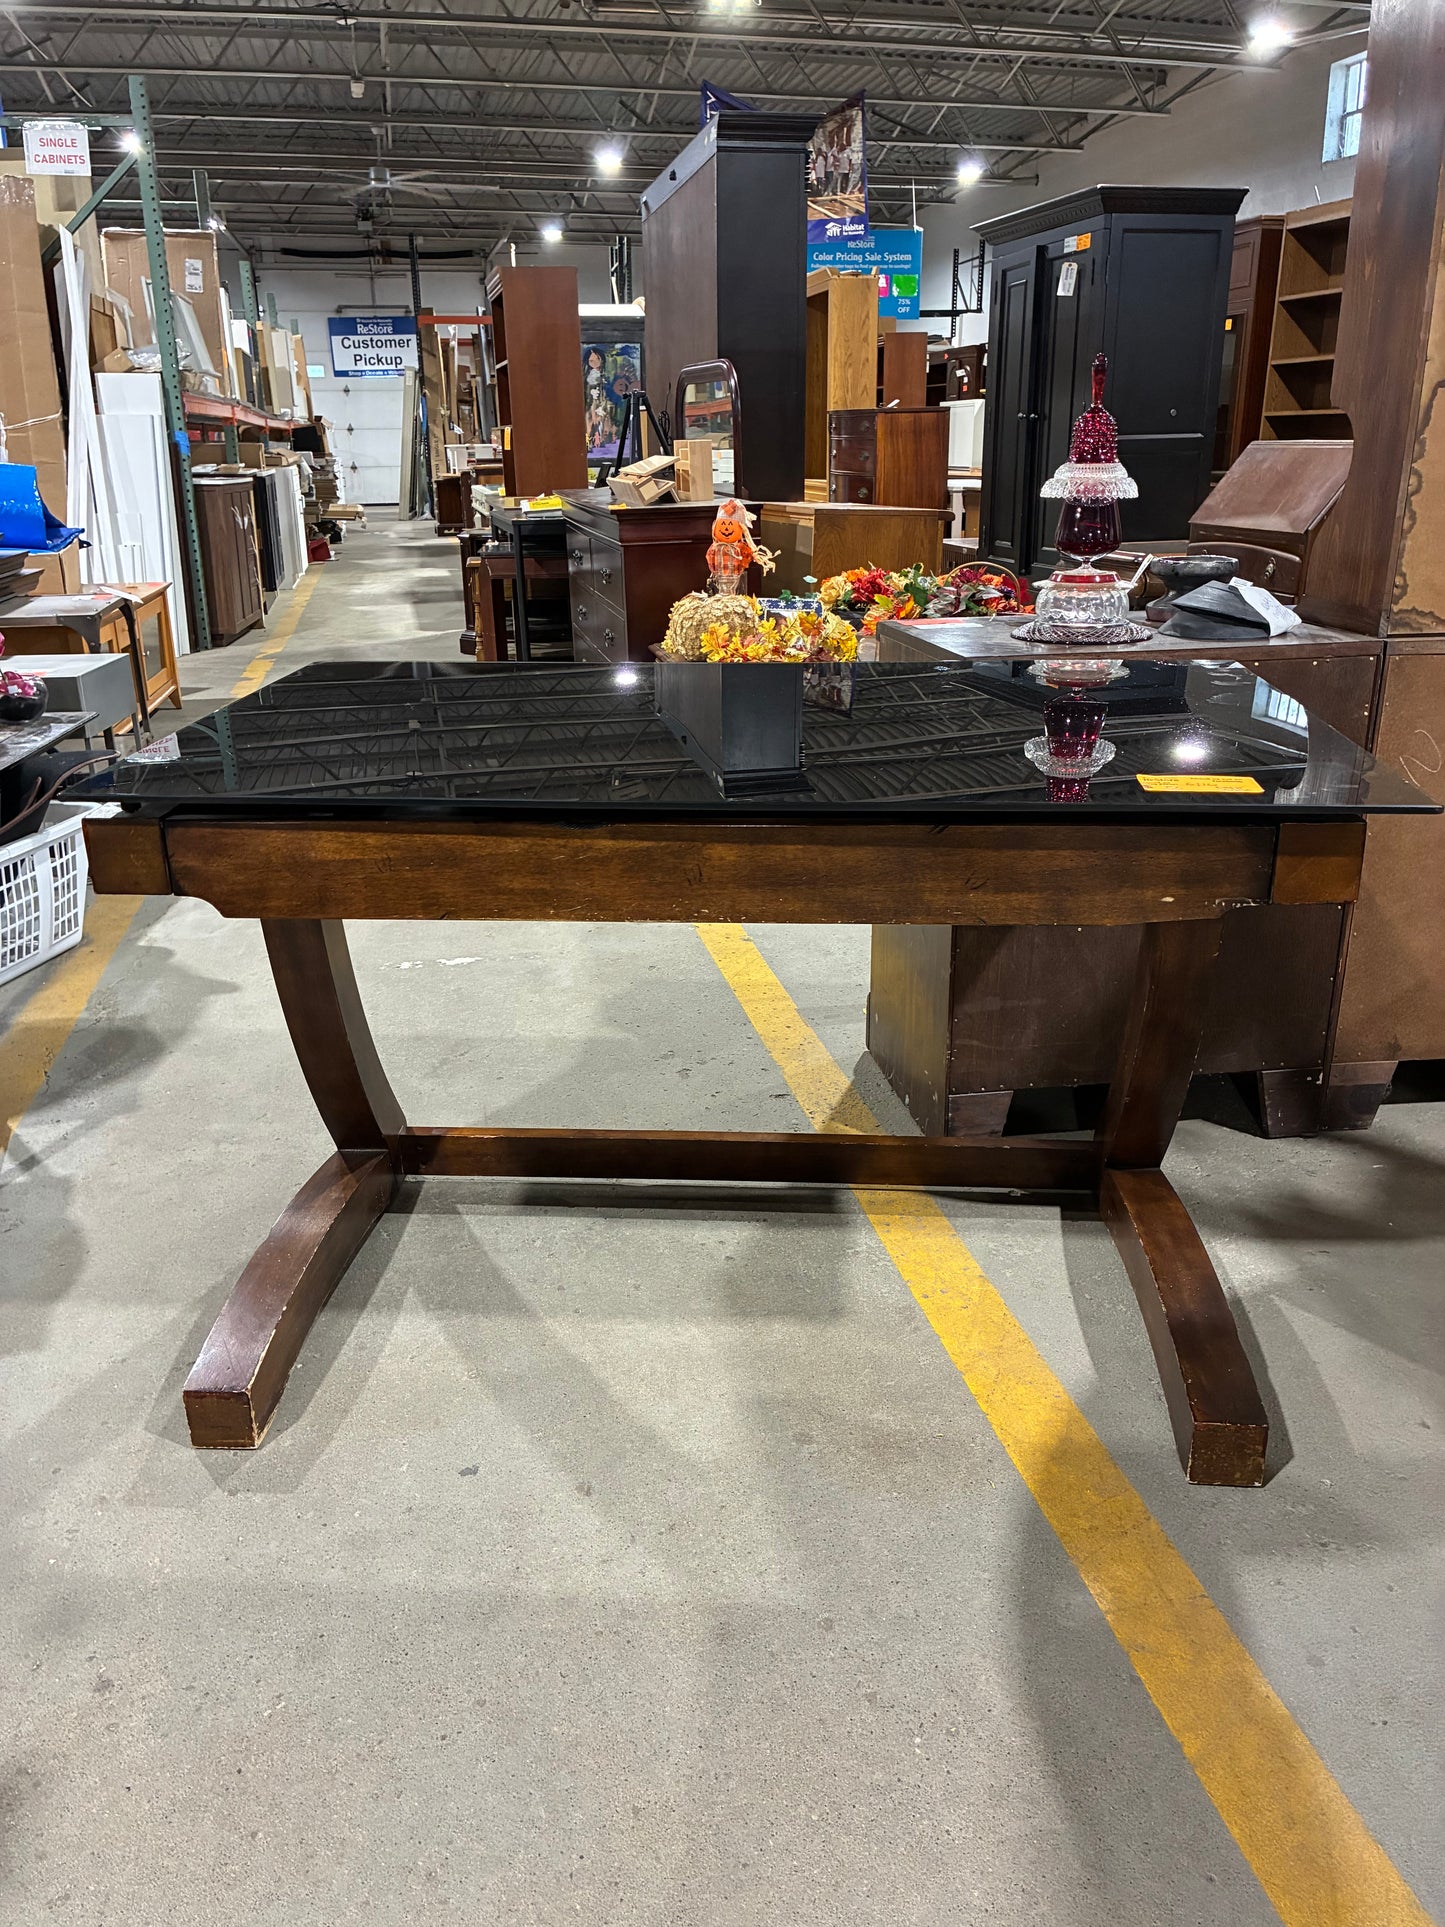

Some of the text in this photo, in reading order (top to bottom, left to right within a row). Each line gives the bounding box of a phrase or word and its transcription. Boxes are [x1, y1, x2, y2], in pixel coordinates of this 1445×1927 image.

[38, 137, 78, 148] SINGLE
[34, 154, 86, 165] CABINETS
[842, 223, 865, 232] Habitat
[847, 240, 875, 248] ReStore
[813, 252, 912, 263] Color Pricing Sale System
[357, 323, 393, 334] ReStore
[341, 336, 412, 349] Customer
[353, 353, 403, 368] Pickup
